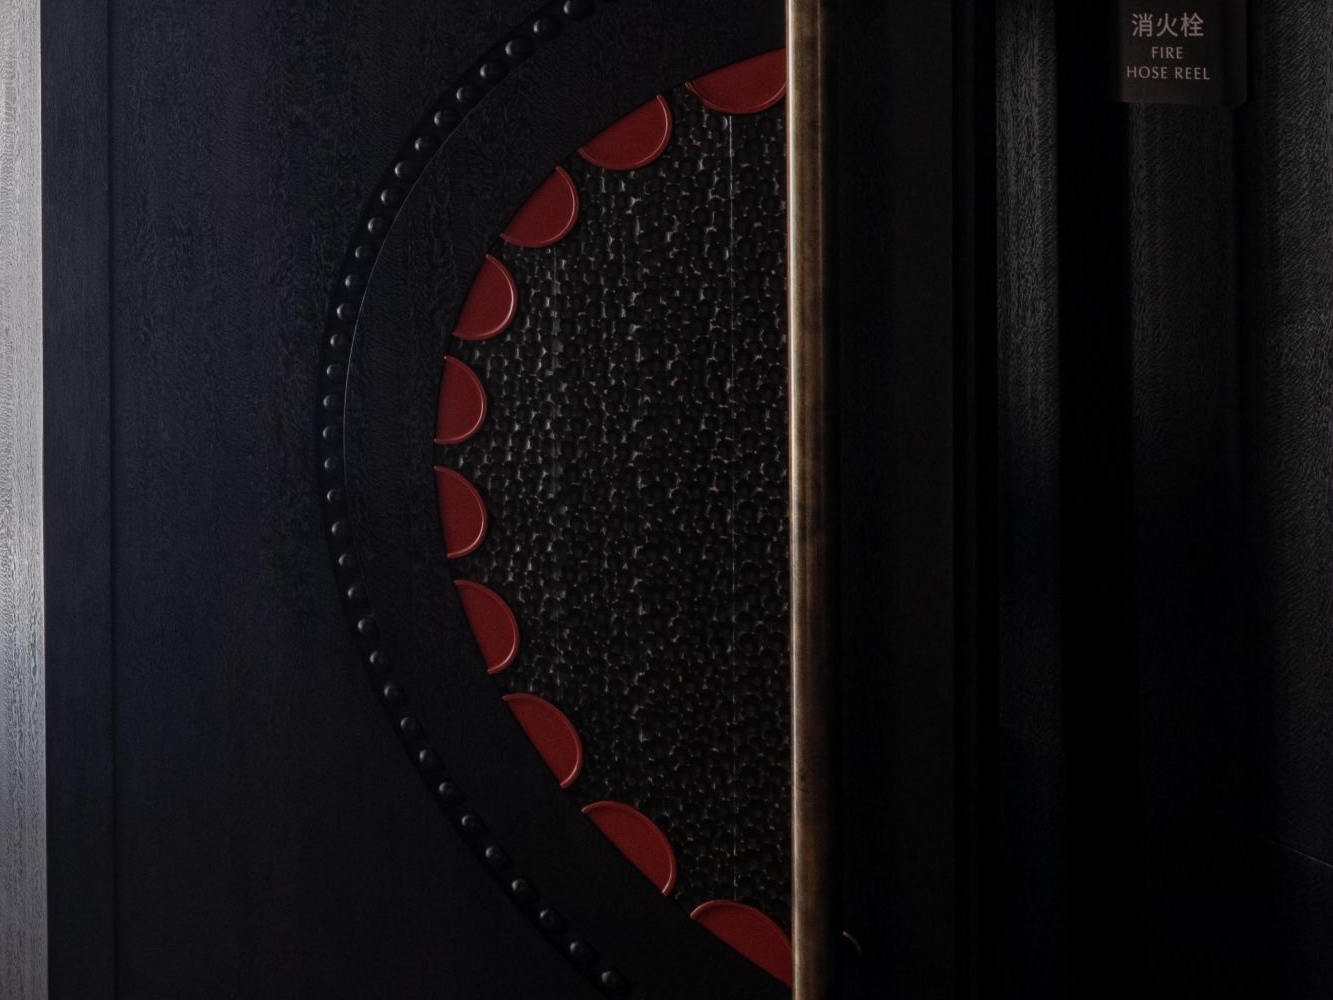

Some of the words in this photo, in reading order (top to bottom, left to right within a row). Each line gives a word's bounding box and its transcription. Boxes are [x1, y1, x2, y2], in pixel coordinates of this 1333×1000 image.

[1131, 12, 1204, 37] 消火栓
[1151, 46, 1184, 59] FIRE
[1126, 65, 1168, 79] HOSE
[1174, 66, 1211, 80] REEL
